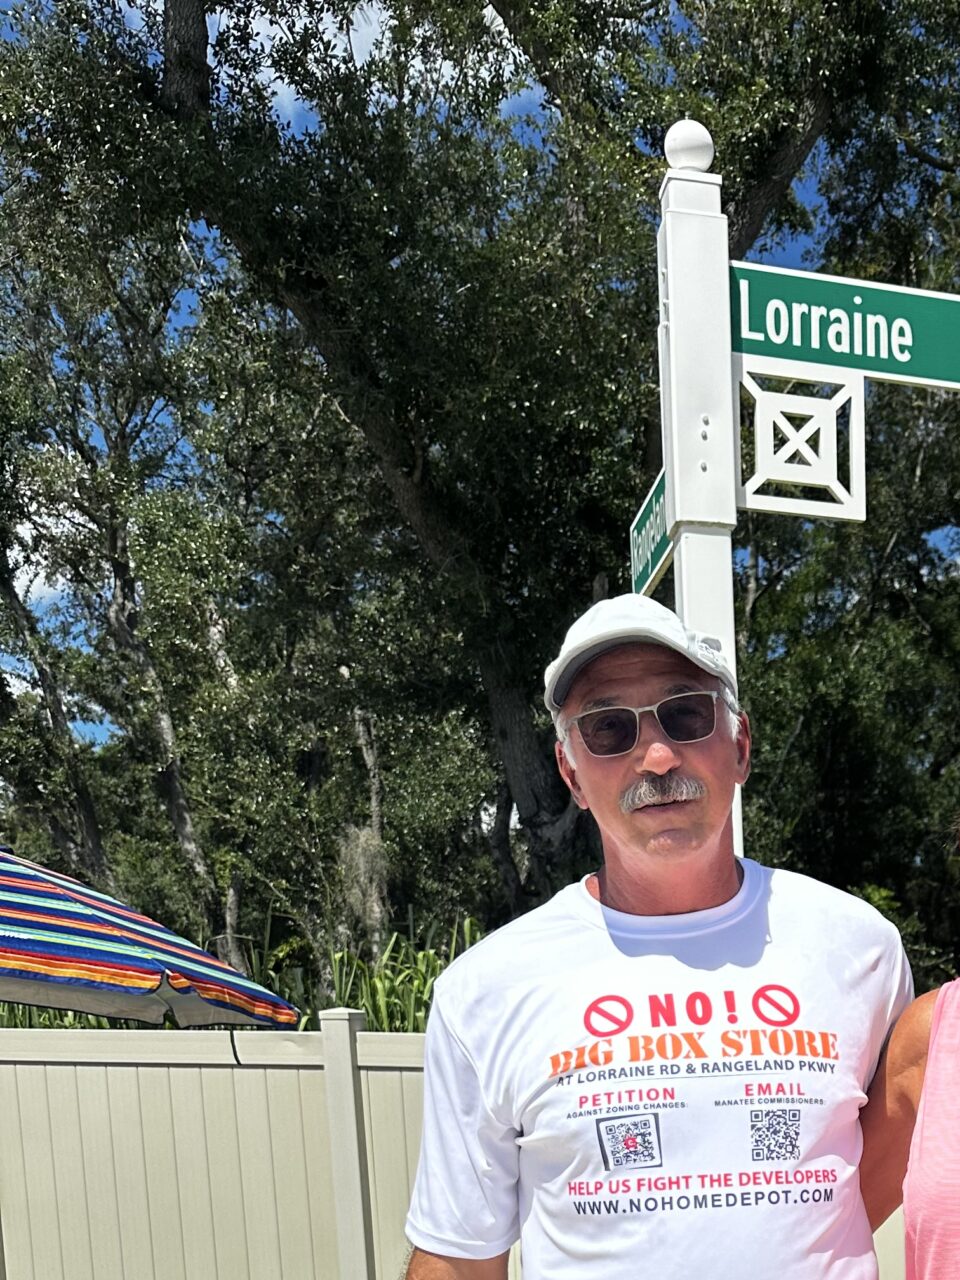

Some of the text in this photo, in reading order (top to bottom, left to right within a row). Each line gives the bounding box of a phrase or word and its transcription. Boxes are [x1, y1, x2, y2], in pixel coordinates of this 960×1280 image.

[740, 279, 912, 362] Lorraine
[632, 494, 666, 581] Rangelan
[648, 991, 738, 1027] NO!
[548, 1029, 838, 1078] BIG BOX STORE
[556, 1060, 835, 1087] AT LORRAINE RD & RANGELAND PKWY
[579, 1088, 675, 1108] PETITION
[745, 1083, 805, 1096] EMAIL
[567, 1108, 602, 1119] AGAINST
[606, 1104, 640, 1113] ZONING
[568, 1169, 837, 1195] HELP US FIGHT THE DEVELOPERS
[573, 1189, 833, 1215] WWW.NOHOMEDEPOT.COM
